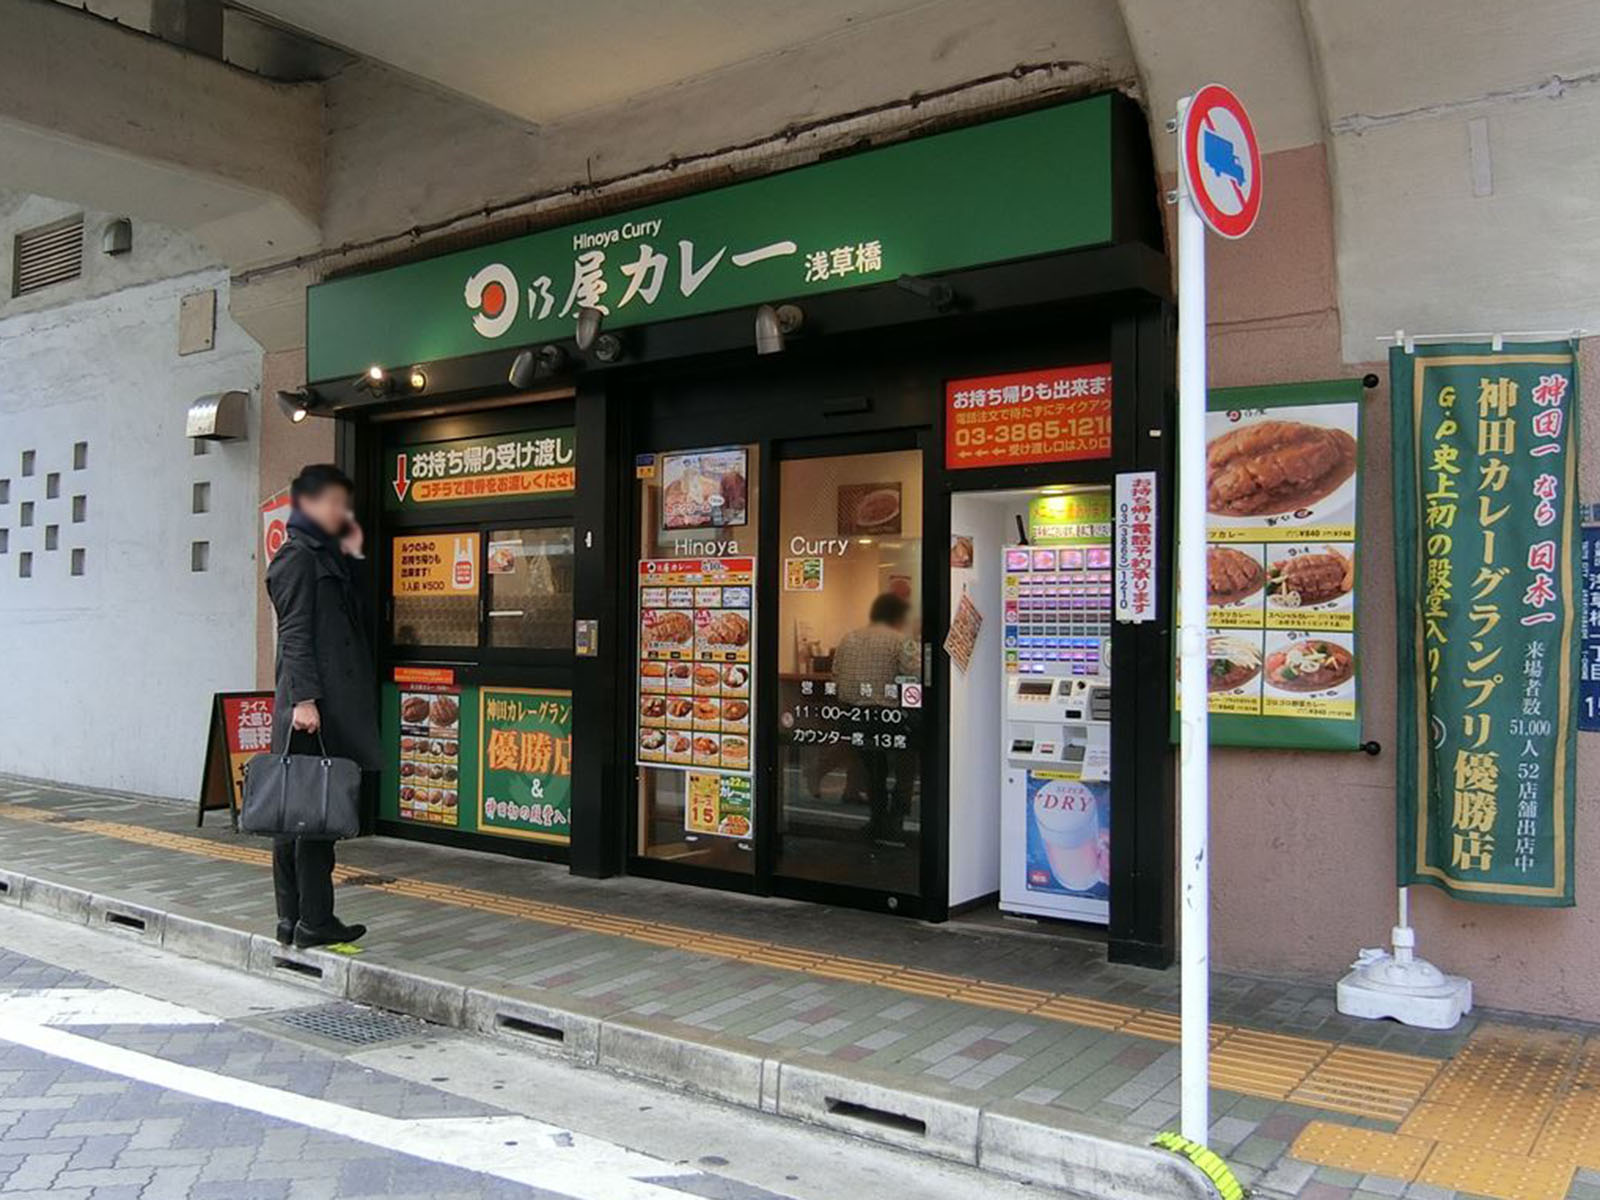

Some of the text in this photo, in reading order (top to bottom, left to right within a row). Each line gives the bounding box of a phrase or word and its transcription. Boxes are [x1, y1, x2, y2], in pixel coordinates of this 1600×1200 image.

[573, 218, 662, 250] Hinoya Curry
[804, 240, 882, 283] 浅草橋
[953, 376, 1112, 408] お持ち帰りも出来ま
[412, 437, 573, 478] お持ち帰り受け渡し
[674, 536, 848, 556] Hinoya Curry
[1450, 377, 1519, 871] 神田カレーグランプリ優勝店
[531, 778, 544, 799] &
[1043, 794, 1092, 814] DRY
